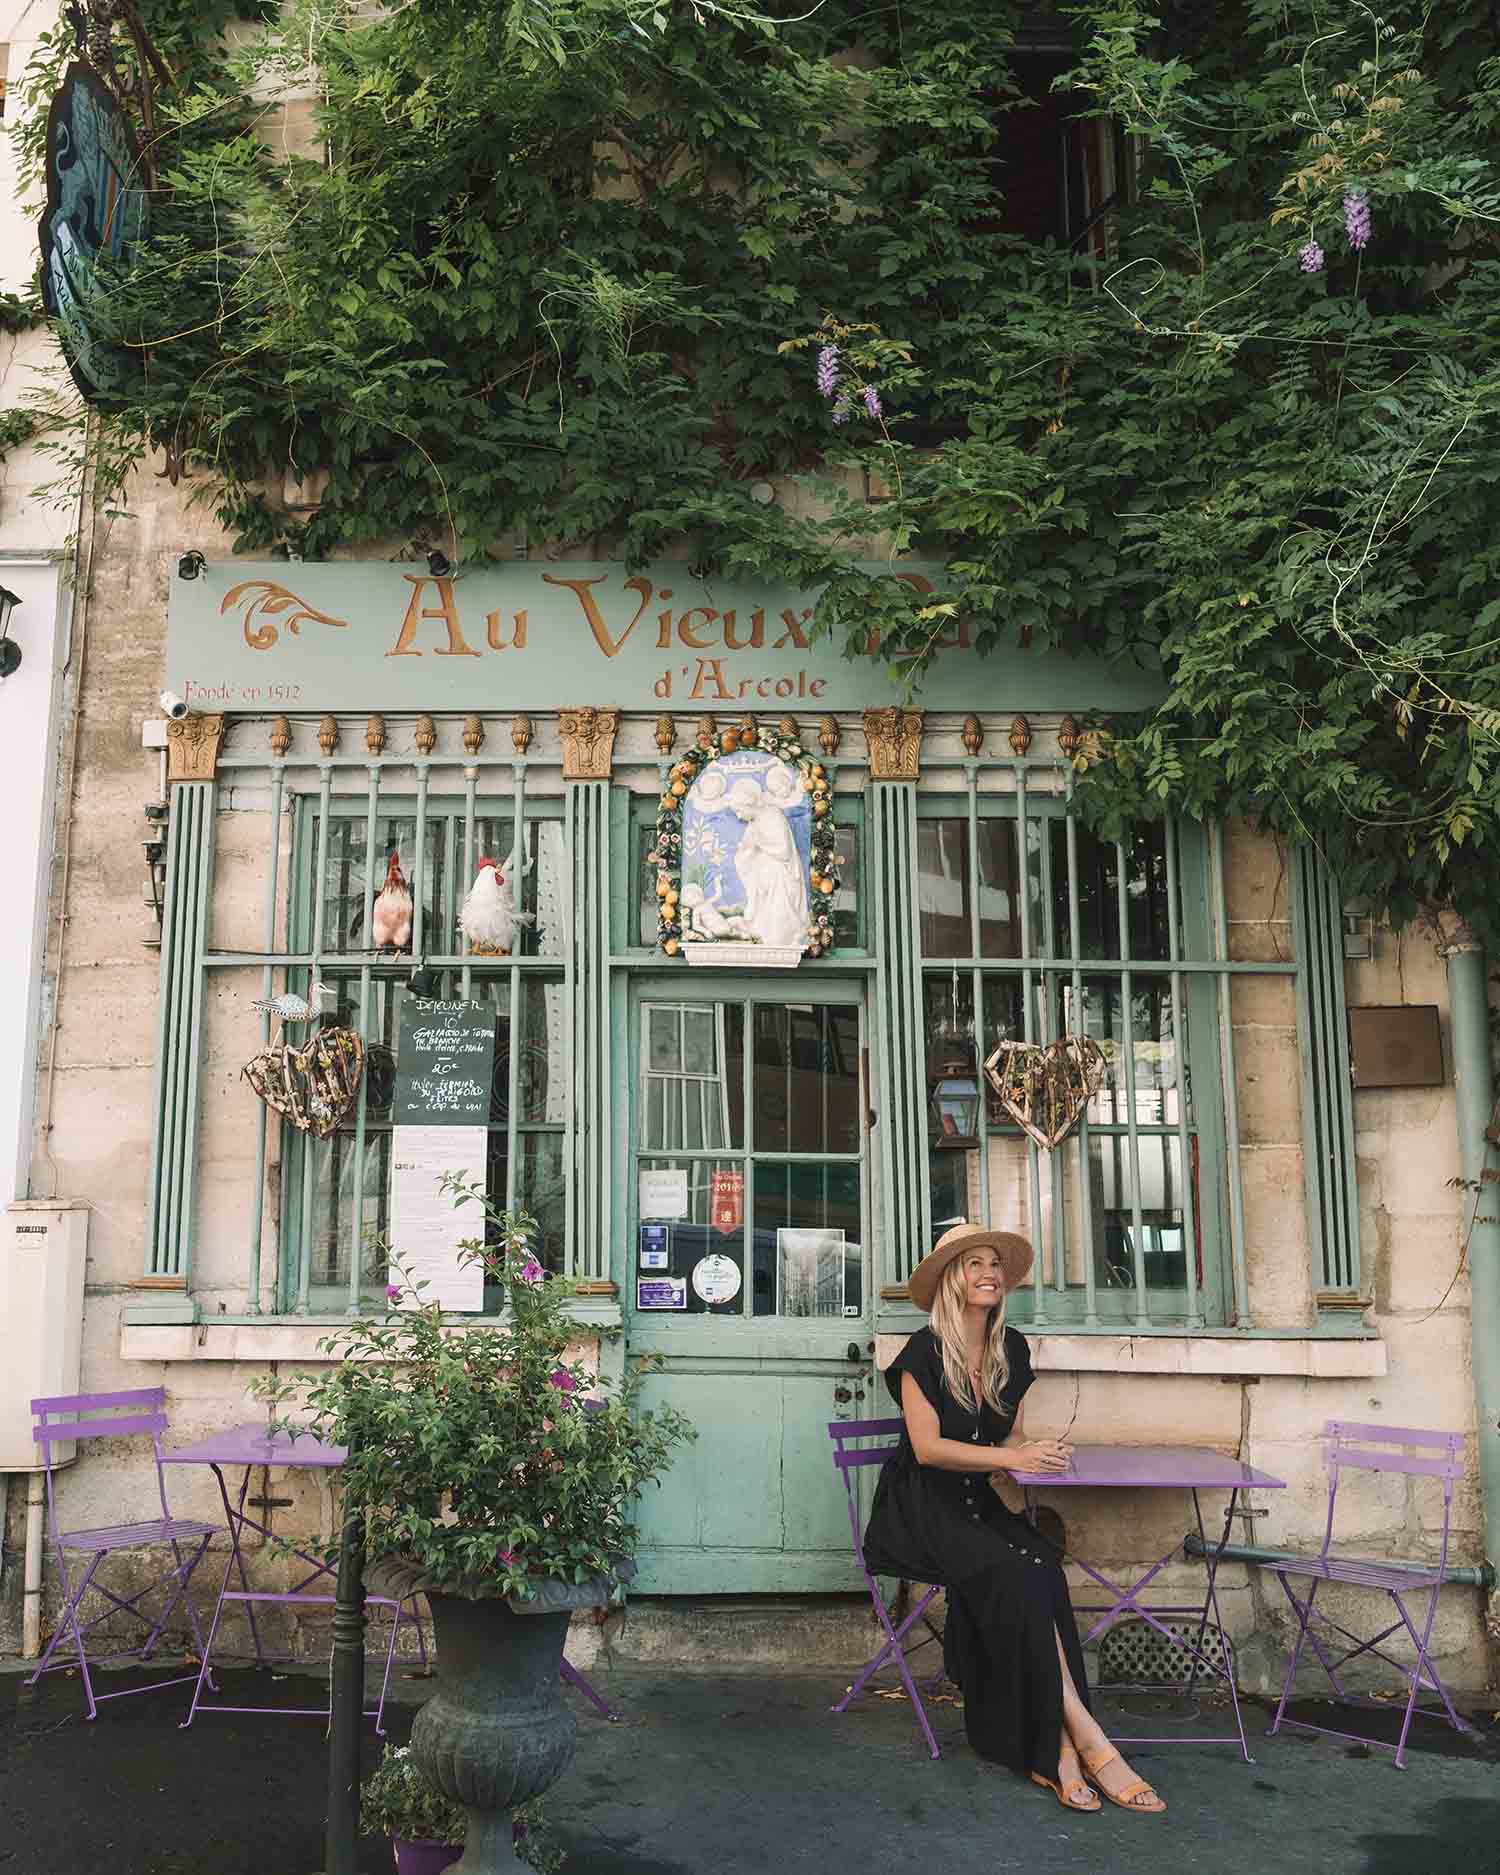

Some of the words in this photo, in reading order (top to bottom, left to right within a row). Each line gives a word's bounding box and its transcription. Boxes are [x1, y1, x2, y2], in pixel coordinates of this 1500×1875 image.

[384, 574, 529, 657] Au
[542, 573, 813, 657] Vieux
[654, 657, 827, 699] d'Arcole
